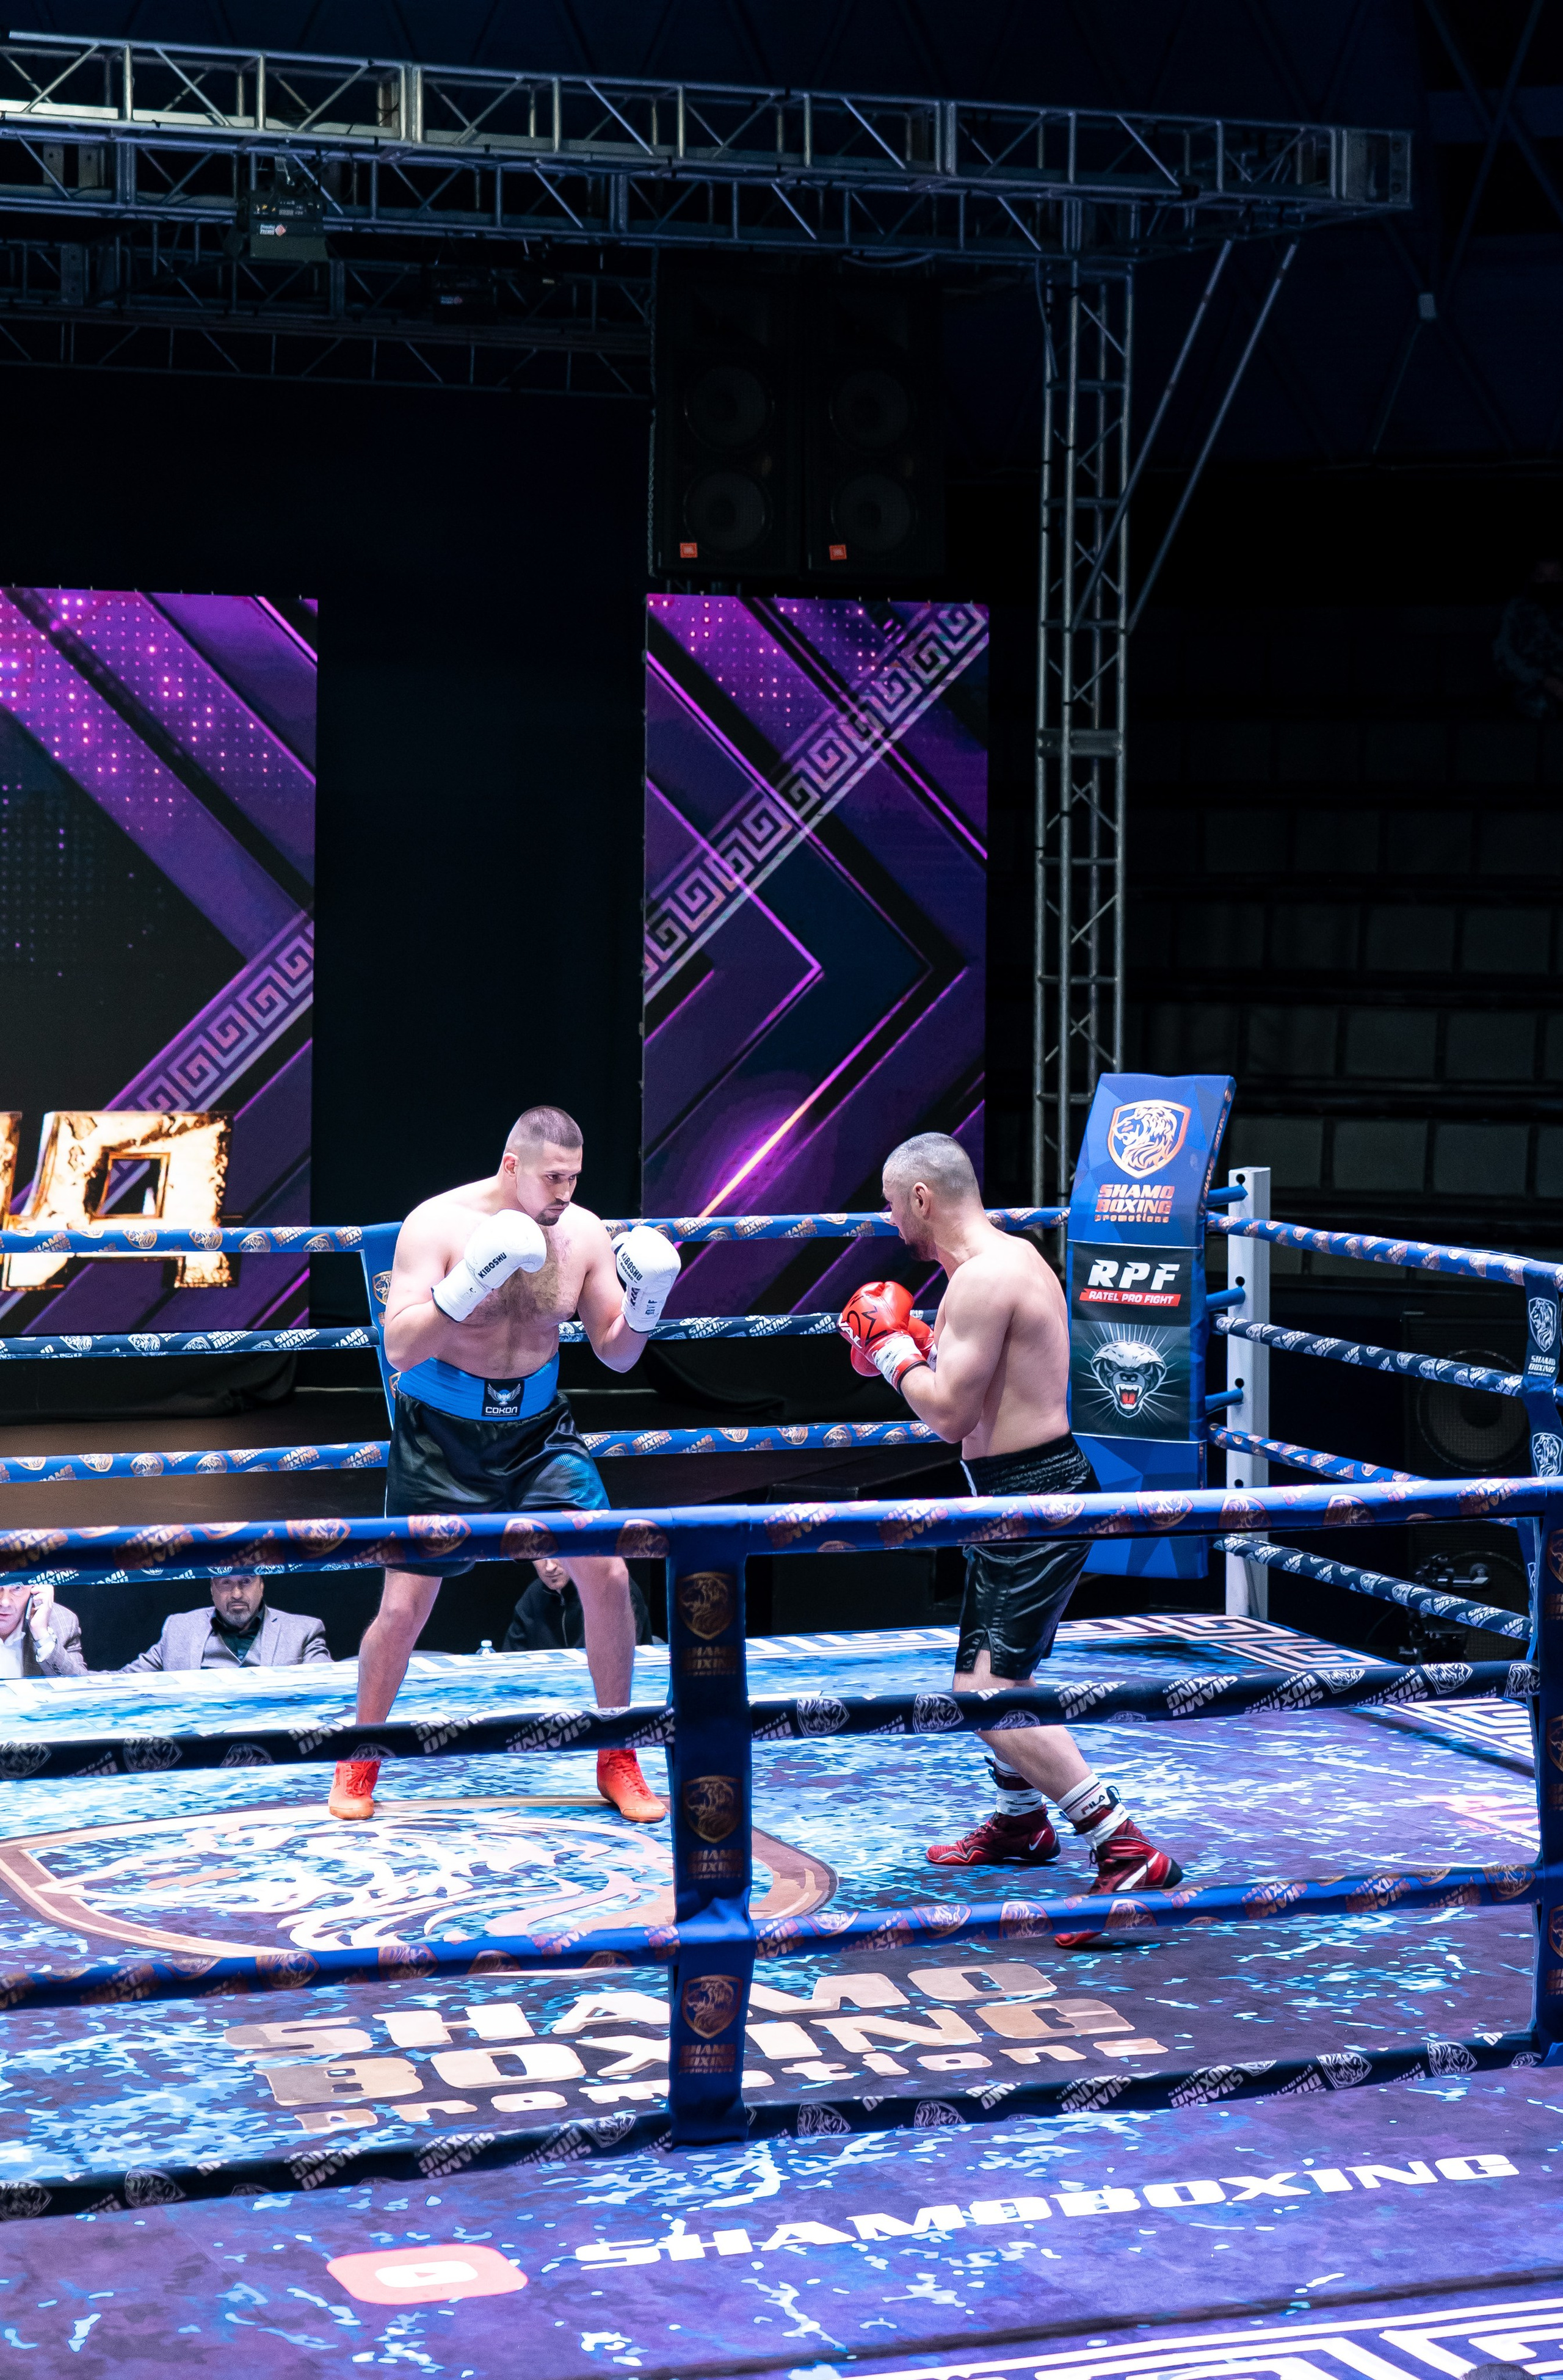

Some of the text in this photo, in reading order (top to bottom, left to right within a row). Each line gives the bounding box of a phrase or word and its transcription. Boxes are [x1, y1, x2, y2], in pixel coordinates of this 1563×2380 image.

[1098, 1184, 1175, 1200] SHAMO
[1095, 1199, 1172, 1214] BOXING
[1095, 1213, 1169, 1223] promotions
[478, 1252, 507, 1279] KIBOSHU
[621, 1251, 643, 1281] KIBOSHU
[1087, 1259, 1180, 1290] RPF
[1089, 1291, 1174, 1305] RATEL PRO FIGHT
[1081, 1794, 1106, 1815] FILA
[575, 2154, 1520, 2270] SHAMOBOXING
